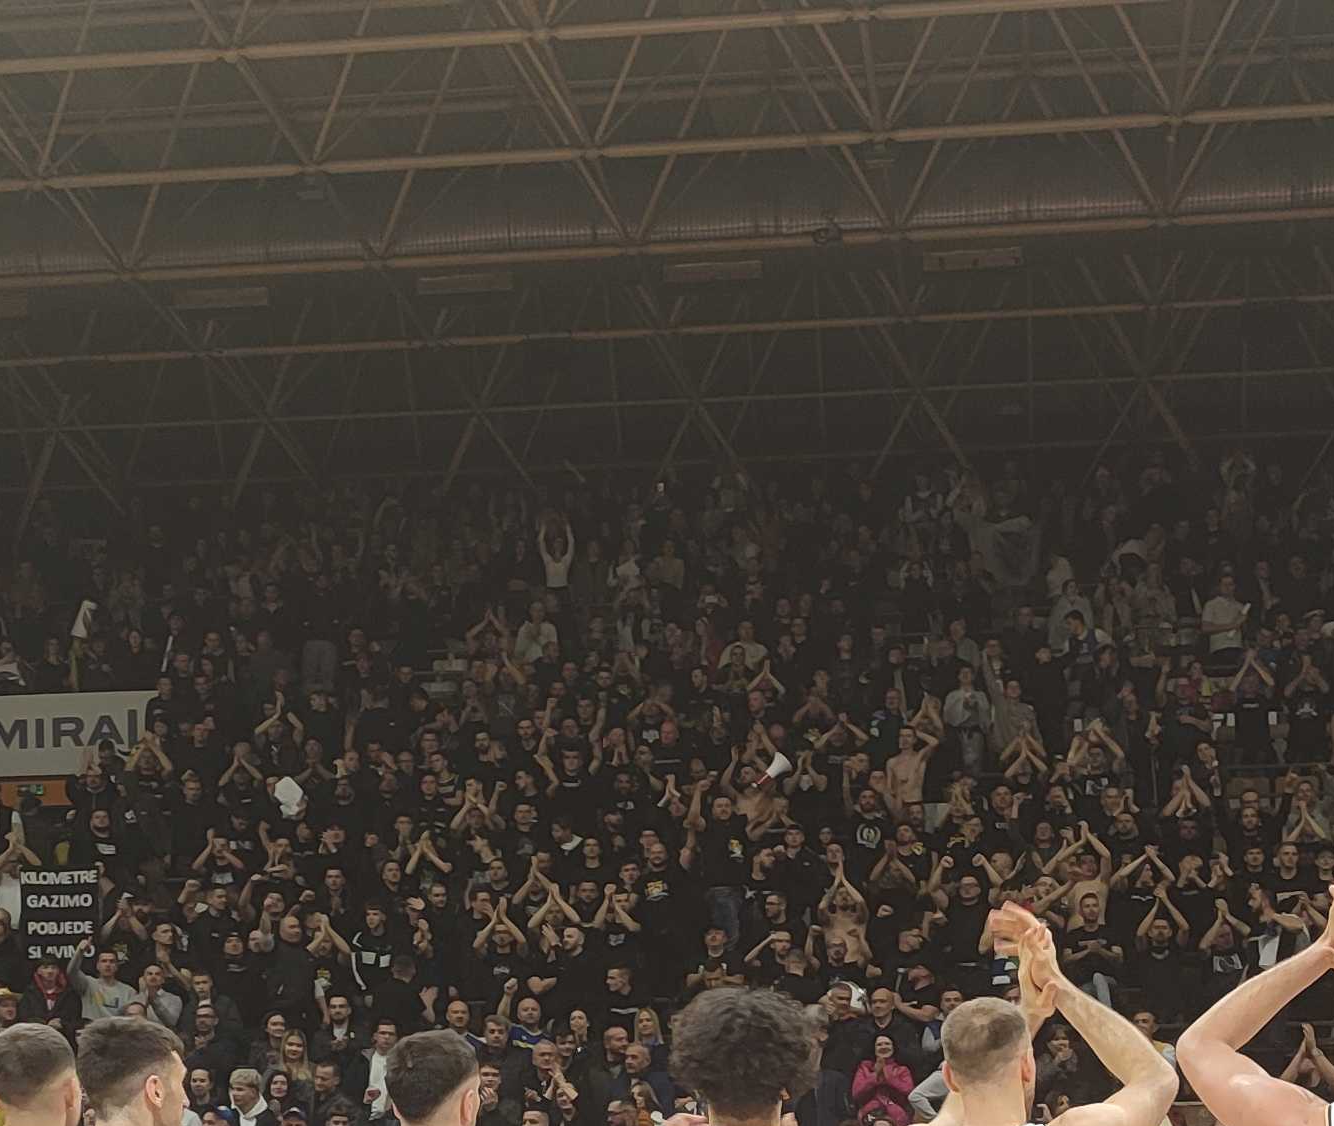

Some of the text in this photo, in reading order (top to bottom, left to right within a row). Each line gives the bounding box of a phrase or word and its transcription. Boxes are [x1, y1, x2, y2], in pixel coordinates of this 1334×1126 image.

[20, 869, 98, 885] KILOMETRE
[26, 893, 93, 908] GAZIMO
[27, 920, 94, 935] POBJEDE
